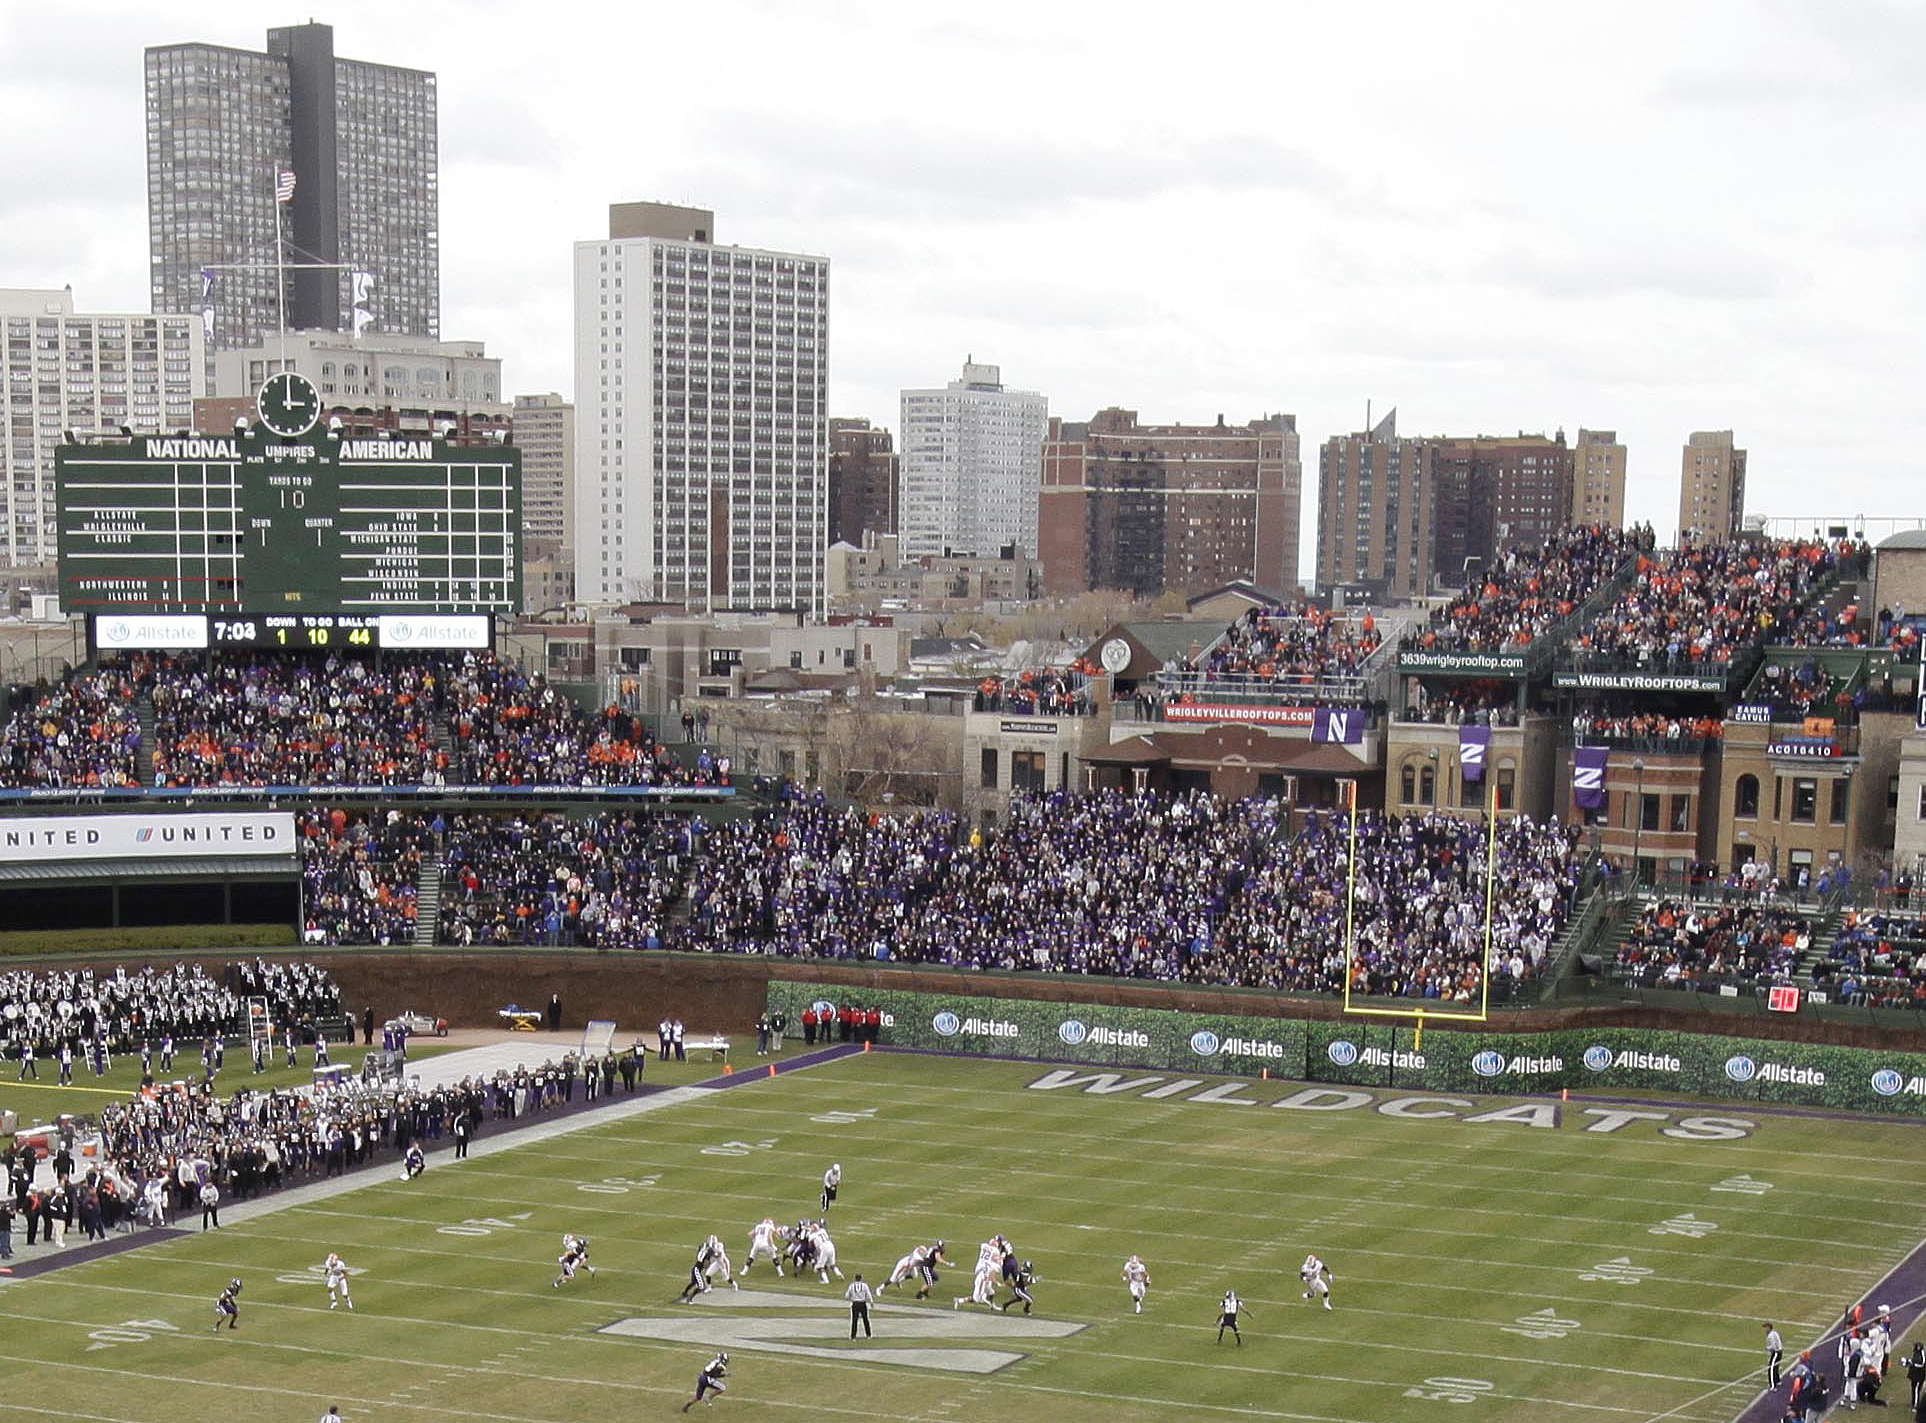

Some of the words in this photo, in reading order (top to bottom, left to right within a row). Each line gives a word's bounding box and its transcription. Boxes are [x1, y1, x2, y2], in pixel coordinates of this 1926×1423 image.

[146, 439, 241, 458] NATIONAL
[265, 445, 315, 457] UMPIRES
[339, 440, 432, 459] AMERICAN
[269, 476, 290, 486] YARDS
[292, 476, 301, 486] TO
[302, 476, 312, 486] GO
[281, 489, 304, 509] 10
[94, 510, 136, 520] ALLSTATE
[396, 512, 417, 521] IOWA
[83, 522, 145, 531] WRIGLEYVILLE
[251, 518, 271, 528] DOWN
[305, 518, 333, 528] QUARTER
[368, 522, 388, 532] OHIO
[393, 522, 417, 532] STATE
[95, 534, 132, 543] CLASSIC
[350, 535, 390, 544] MICHIGAN
[393, 535, 418, 544] STATE
[385, 546, 418, 555] PURDUE
[375, 558, 418, 567] MICHIGAN
[368, 569, 419, 578] WISCONSIN
[79, 580, 148, 589] NORTHWESTERN
[382, 581, 418, 590] INDIANA
[108, 592, 148, 601] ILLINOIS
[370, 592, 392, 601] PENN
[395, 592, 418, 601] STATE
[266, 617, 296, 627] DOWN
[302, 617, 316, 627] TO
[317, 617, 333, 627] GO
[338, 617, 363, 627] BALL
[364, 617, 379, 627] ON
[135, 624, 197, 640] Allstate
[277, 629, 286, 644] 1
[308, 629, 328, 644] 10
[349, 629, 370, 644] 44
[417, 624, 478, 640] Allstate
[1400, 653, 1523, 669] 3639wrigleyrooftop.com
[1167, 706, 1312, 722] WRIGLEYVILLEROOFTOPS.COM
[1737, 705, 1769, 714] EAMUS
[1327, 712, 1348, 742] N
[162, 826, 276, 842] UNITED
[960, 1018, 1018, 1037] Allstate
[1086, 1026, 1149, 1047] Allstate
[1220, 1038, 1283, 1058] Allstate
[1358, 1047, 1425, 1069] Allstate
[1506, 1054, 1563, 1074] Allstate
[1613, 1050, 1681, 1072] Allstate
[1756, 1063, 1825, 1086] Allstate
[1027, 1069, 1757, 1140] WILDCATS
